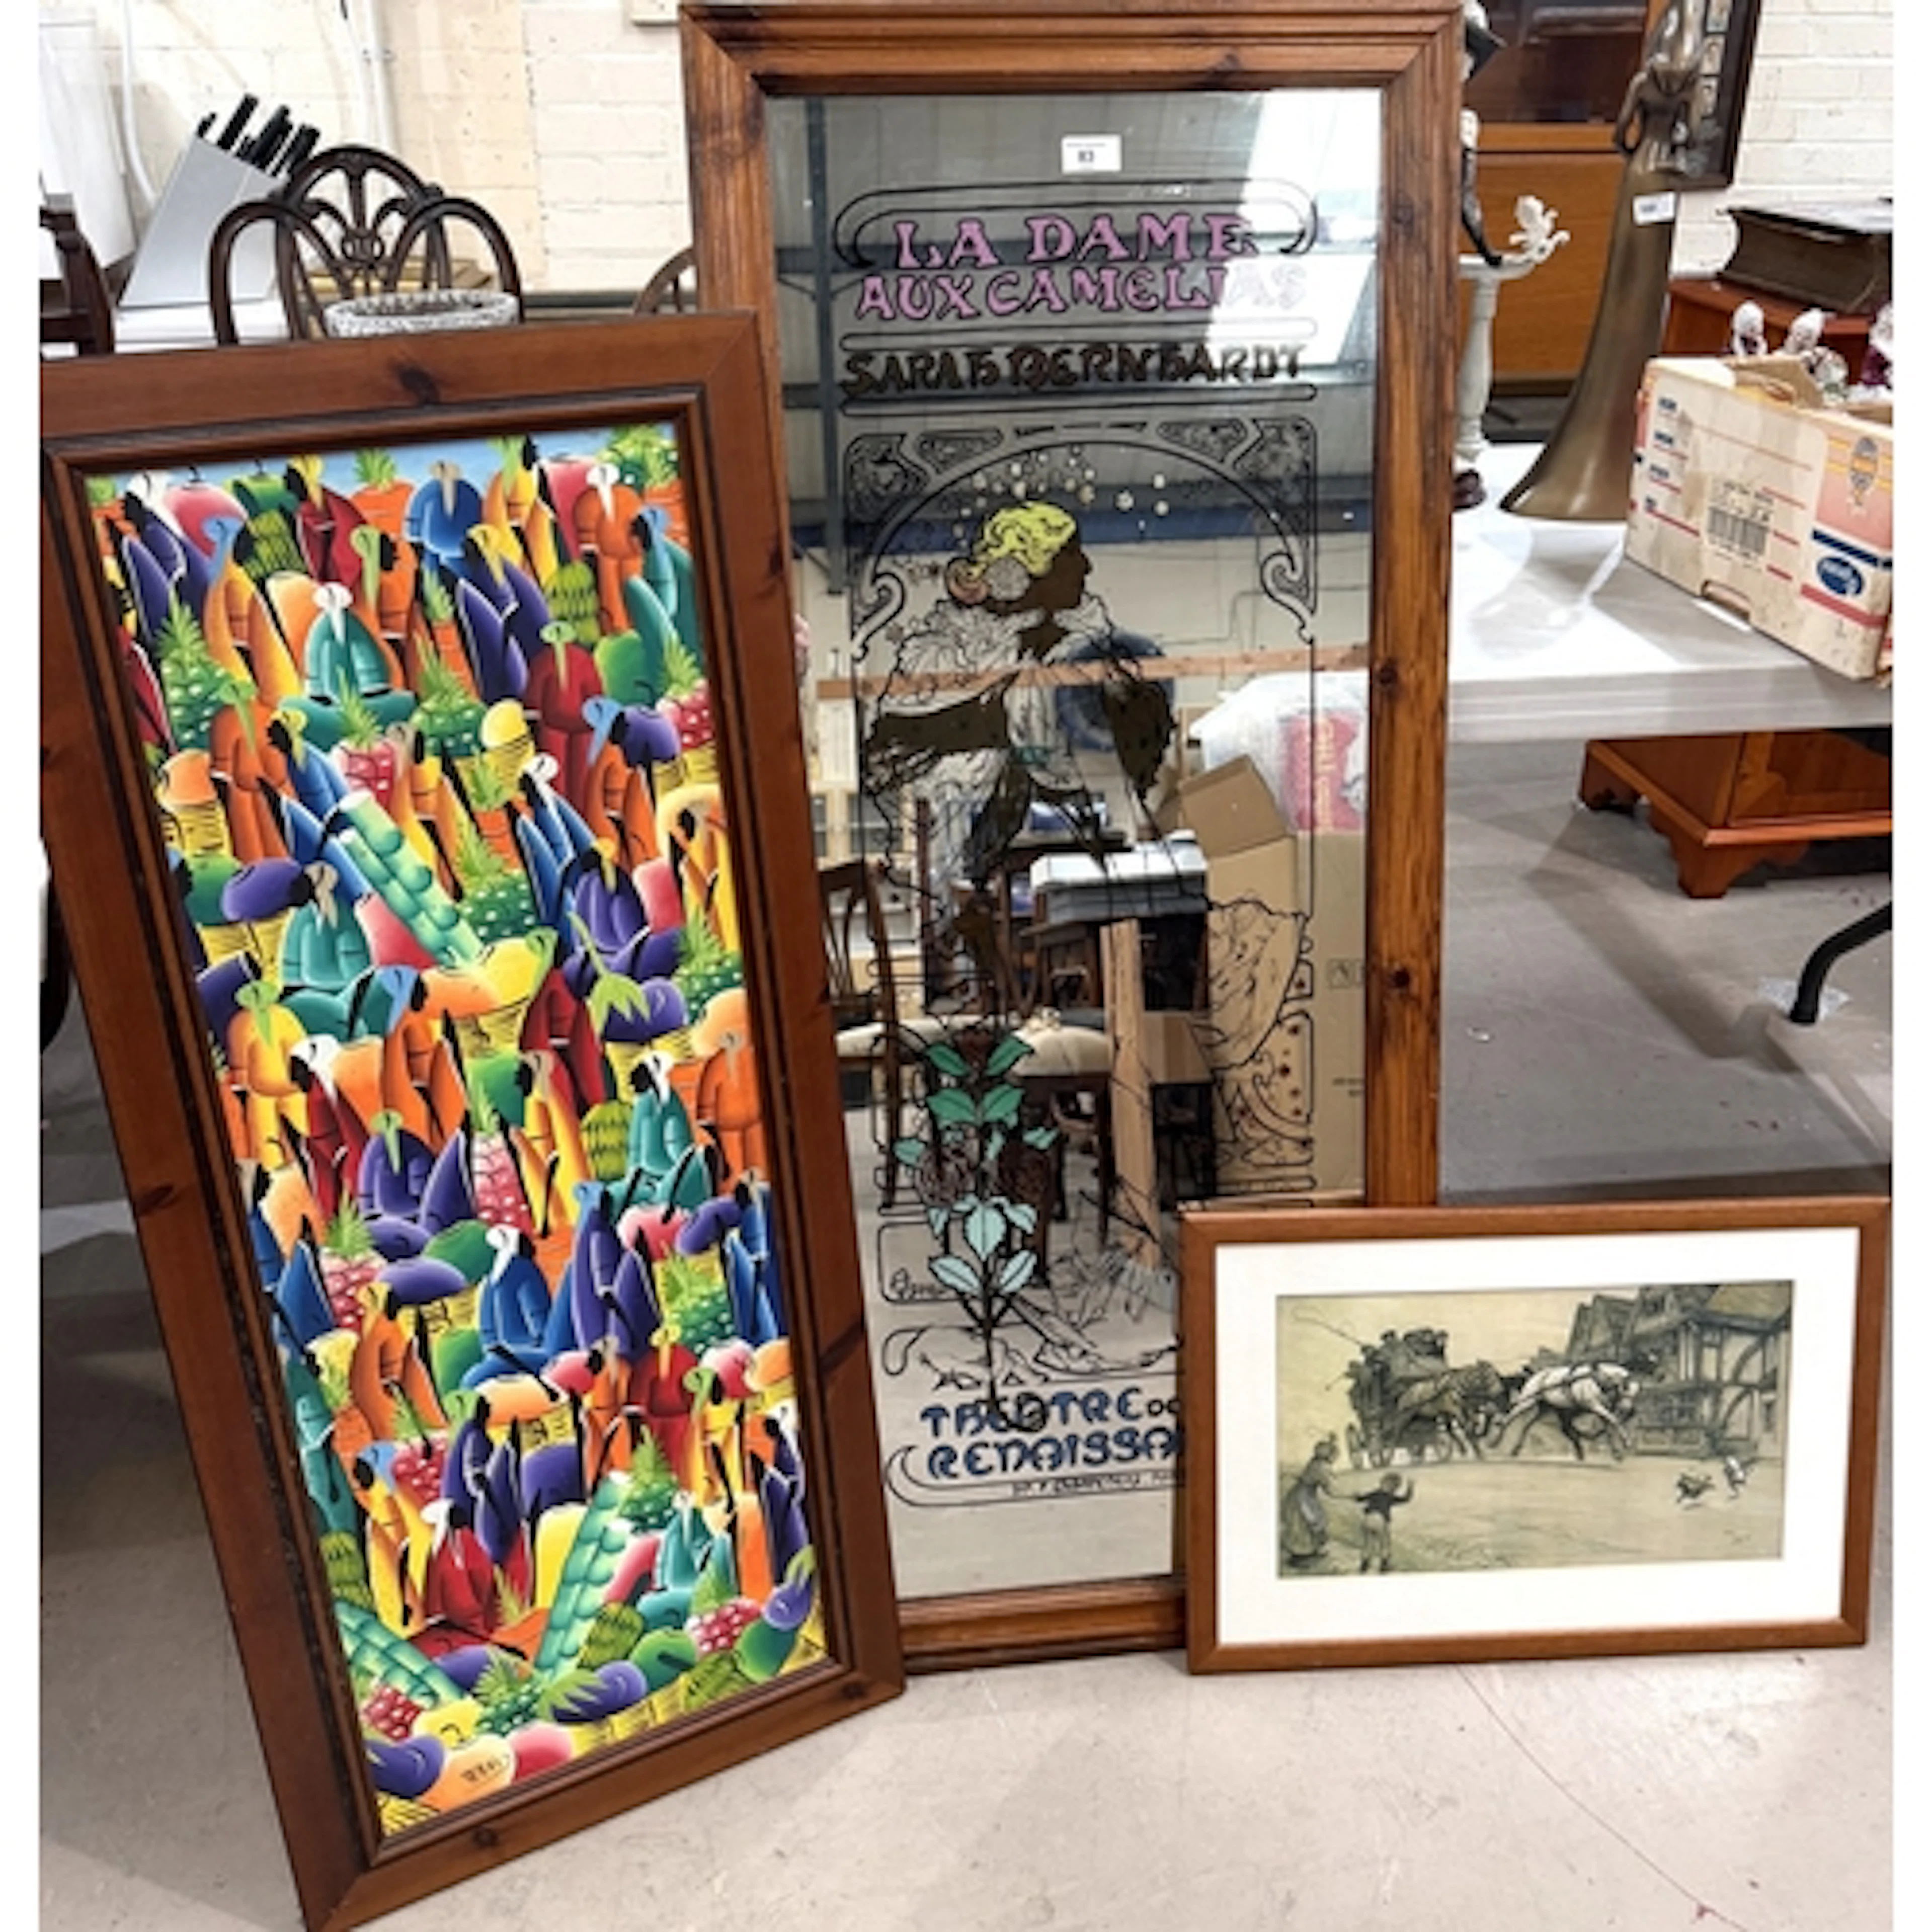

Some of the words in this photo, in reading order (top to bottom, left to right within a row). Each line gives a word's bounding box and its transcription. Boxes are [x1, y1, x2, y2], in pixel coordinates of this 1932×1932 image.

[894, 217, 1001, 269] LA
[1025, 213, 1259, 263] DAME
[856, 274, 981, 320] AUX
[987, 264, 1307, 315] CAMELIAS
[841, 352, 1000, 394] SARAH
[1006, 344, 1305, 391] BERNHARDT
[929, 1427, 1180, 1479] RENAISSA
